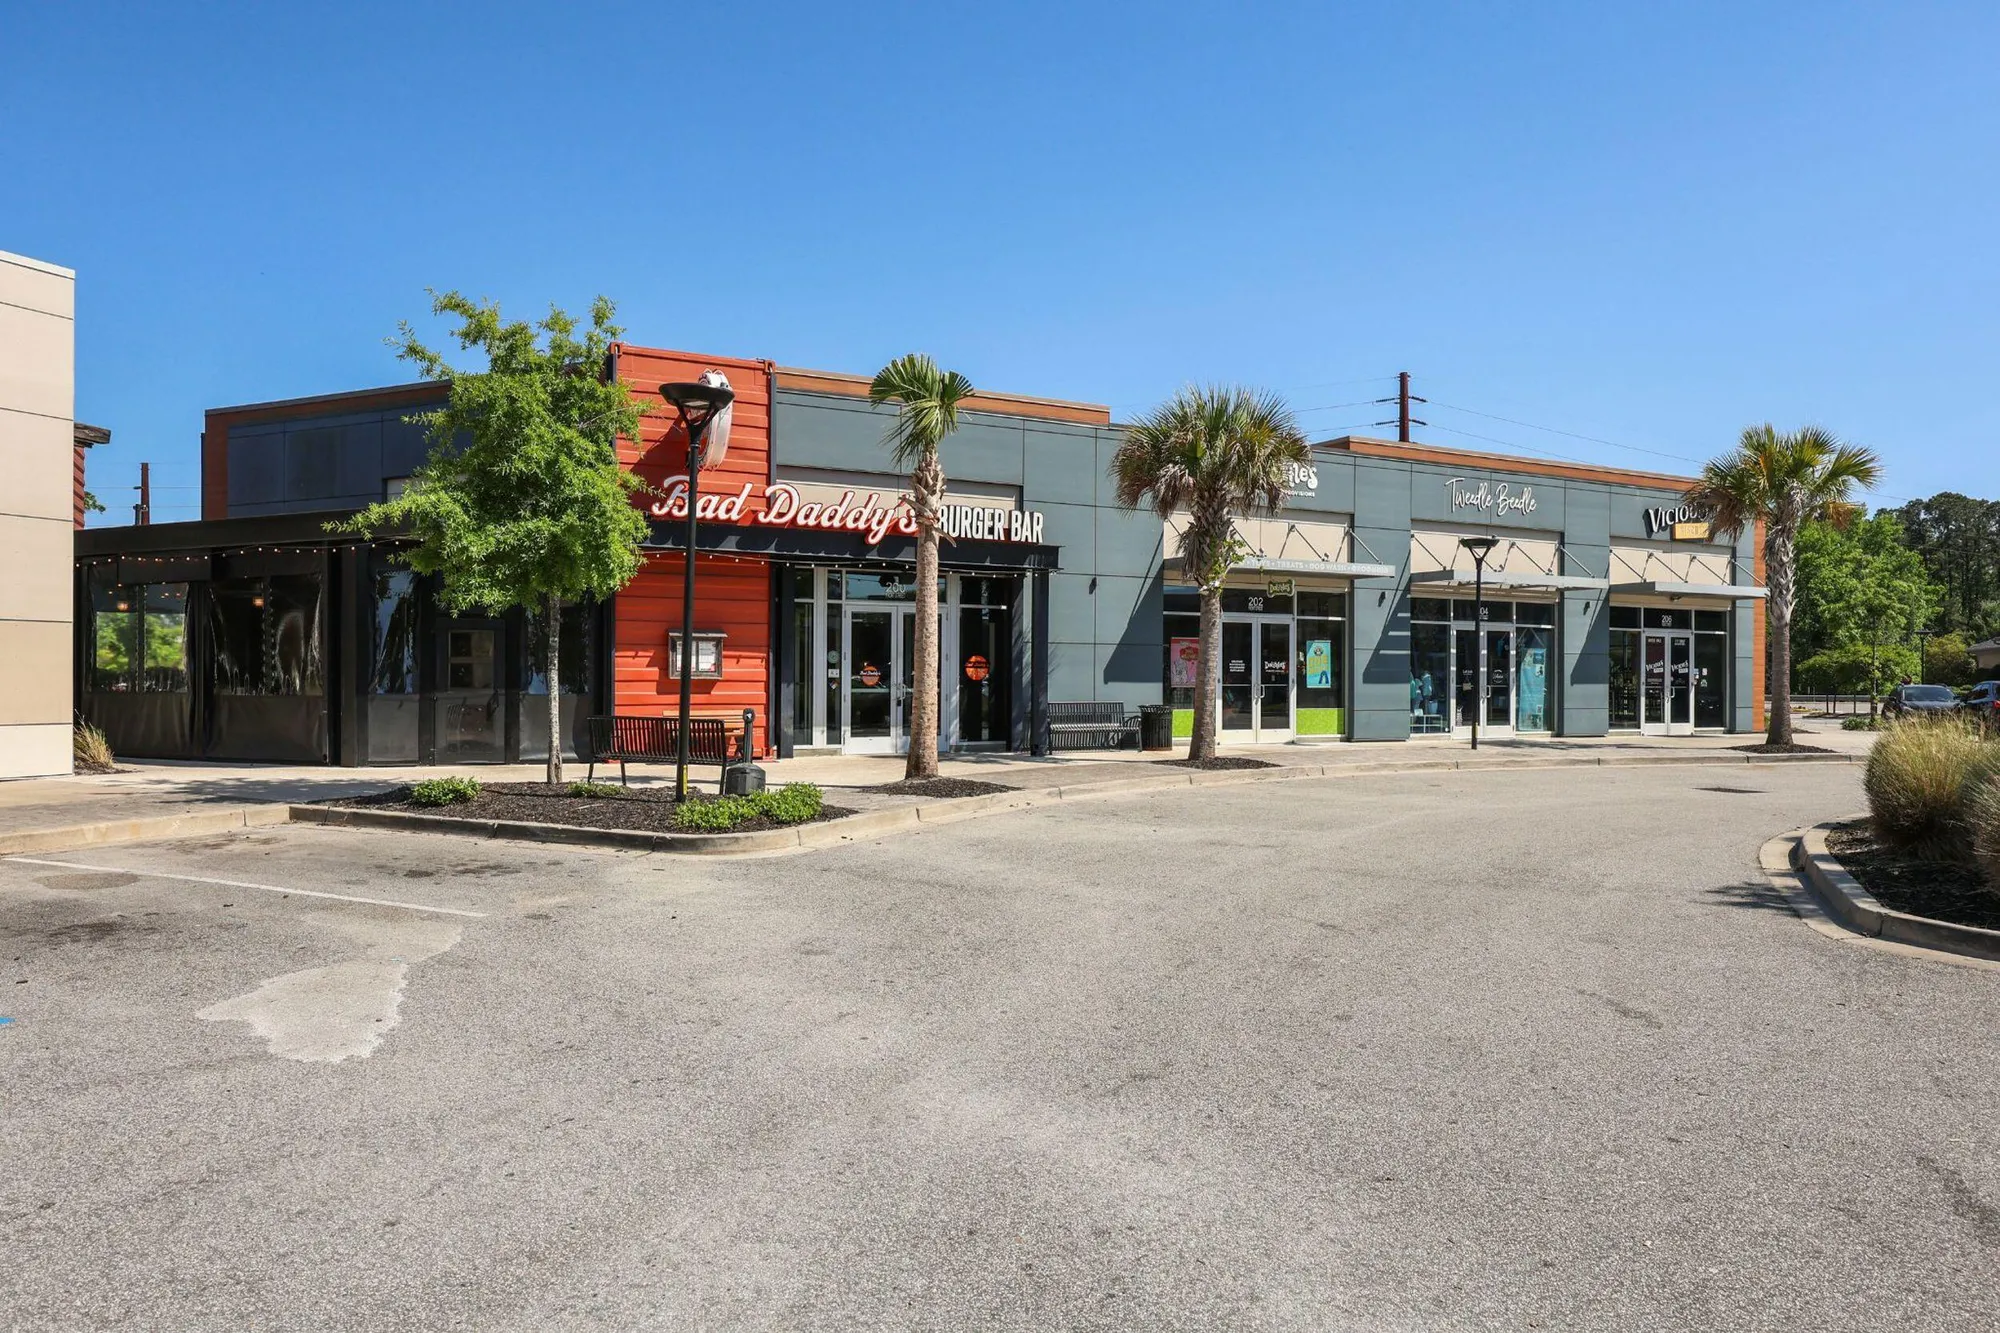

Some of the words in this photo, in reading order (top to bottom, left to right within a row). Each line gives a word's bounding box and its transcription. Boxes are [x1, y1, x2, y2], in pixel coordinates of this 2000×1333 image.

[1444, 478, 1493, 512] Tweedle
[1496, 483, 1537, 516] Beedle
[652, 475, 753, 521] Bad
[758, 483, 919, 545] Daddy's
[939, 506, 1005, 541] BURGER
[1010, 510, 1044, 543] BAR
[1277, 561, 1304, 569] TREATS
[1248, 597, 1264, 606] 202
[1480, 607, 1489, 615] 04
